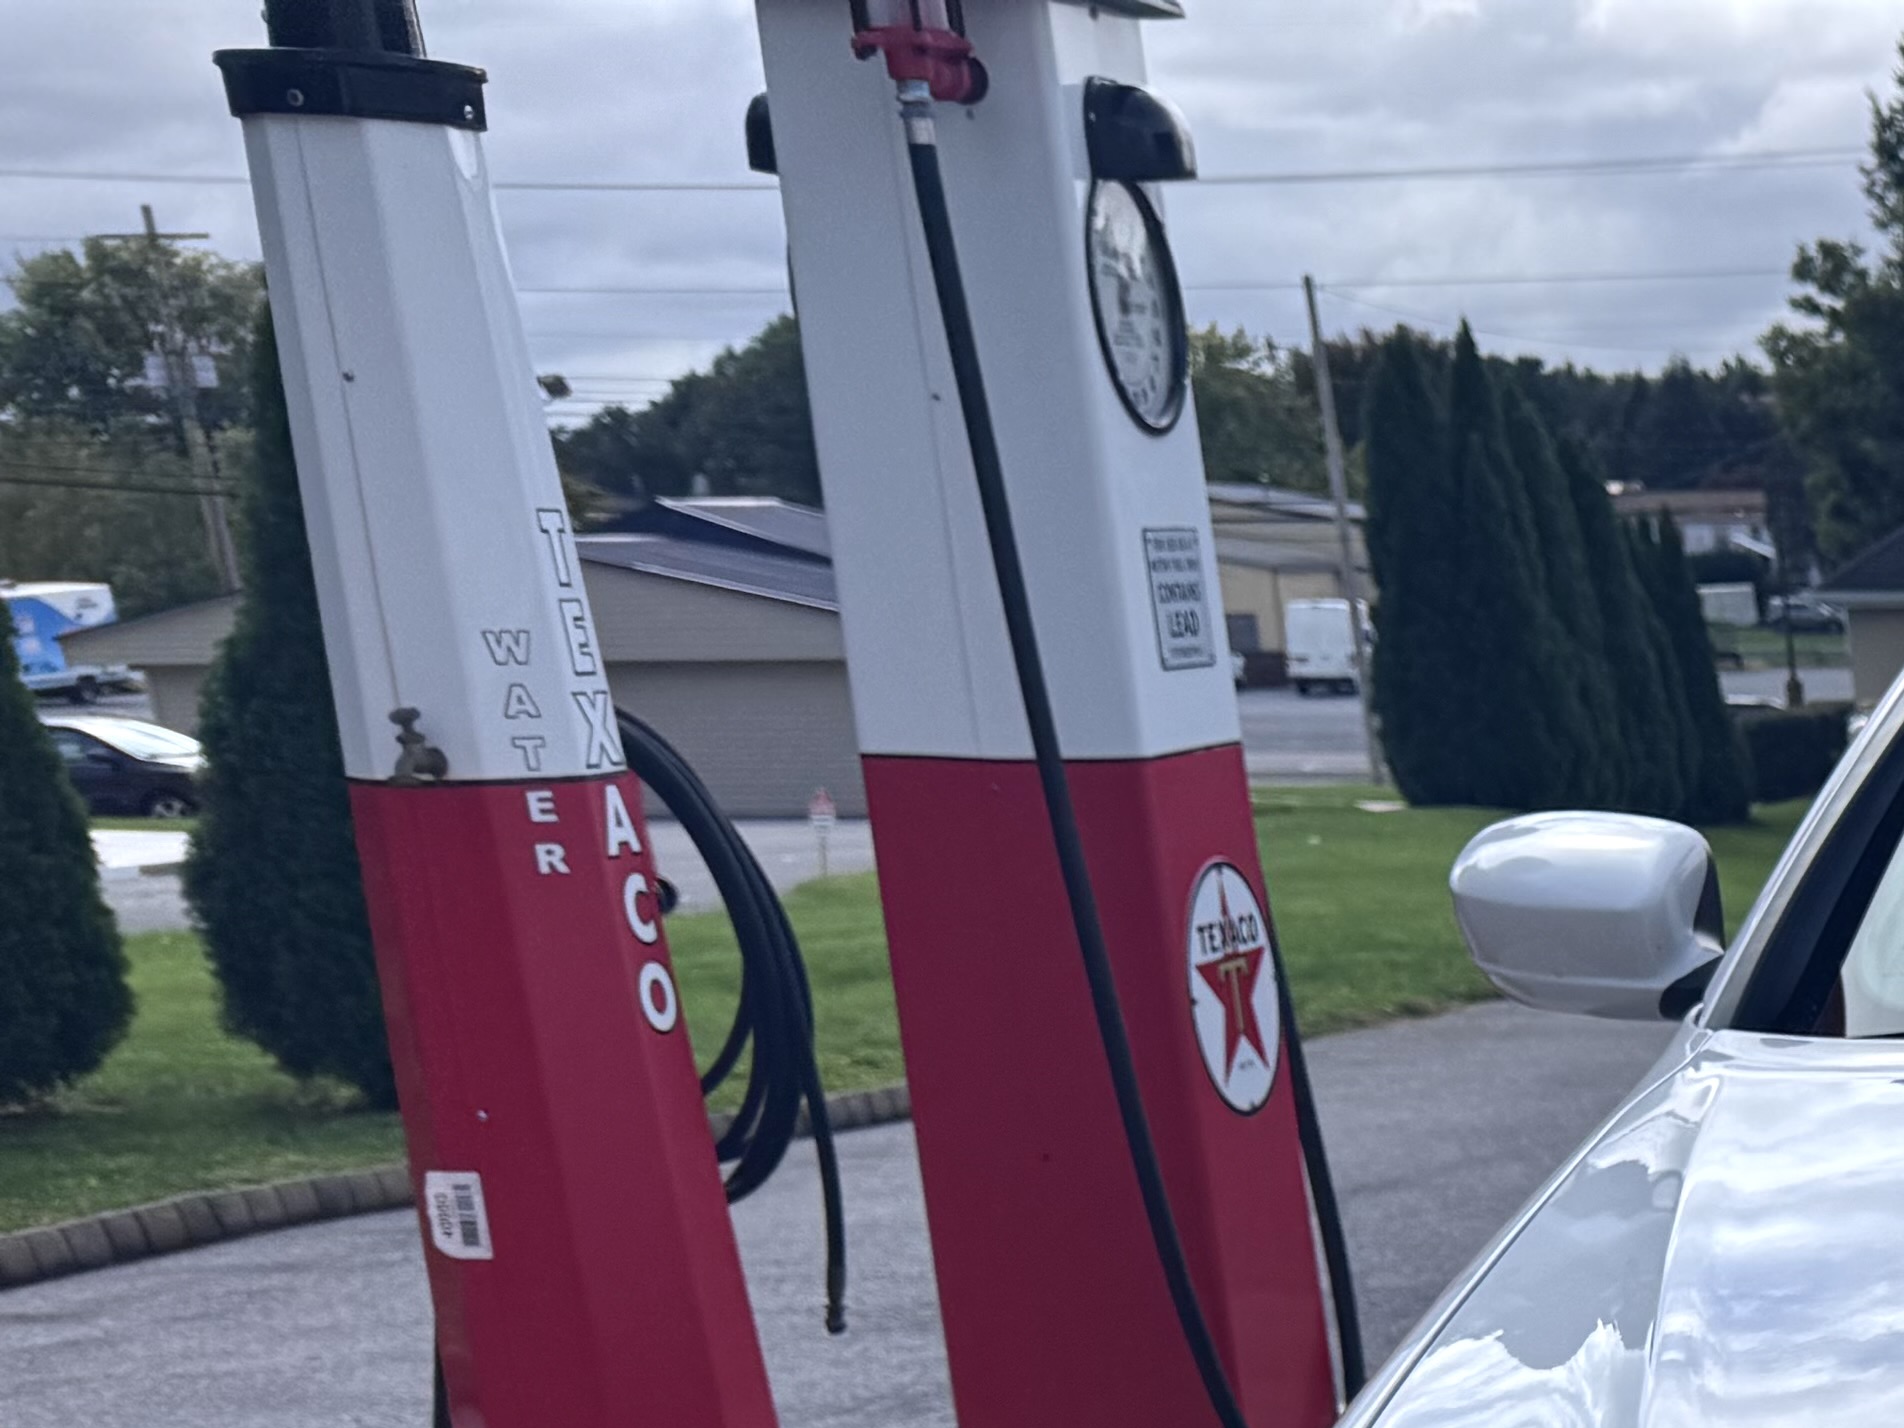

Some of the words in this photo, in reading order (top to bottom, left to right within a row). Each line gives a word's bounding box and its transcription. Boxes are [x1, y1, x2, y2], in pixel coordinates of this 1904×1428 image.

[1166, 609, 1200, 638] LEAD
[482, 628, 571, 875] WATER
[536, 507, 678, 1034] TEXACO
[1196, 913, 1260, 956] TEXACO
